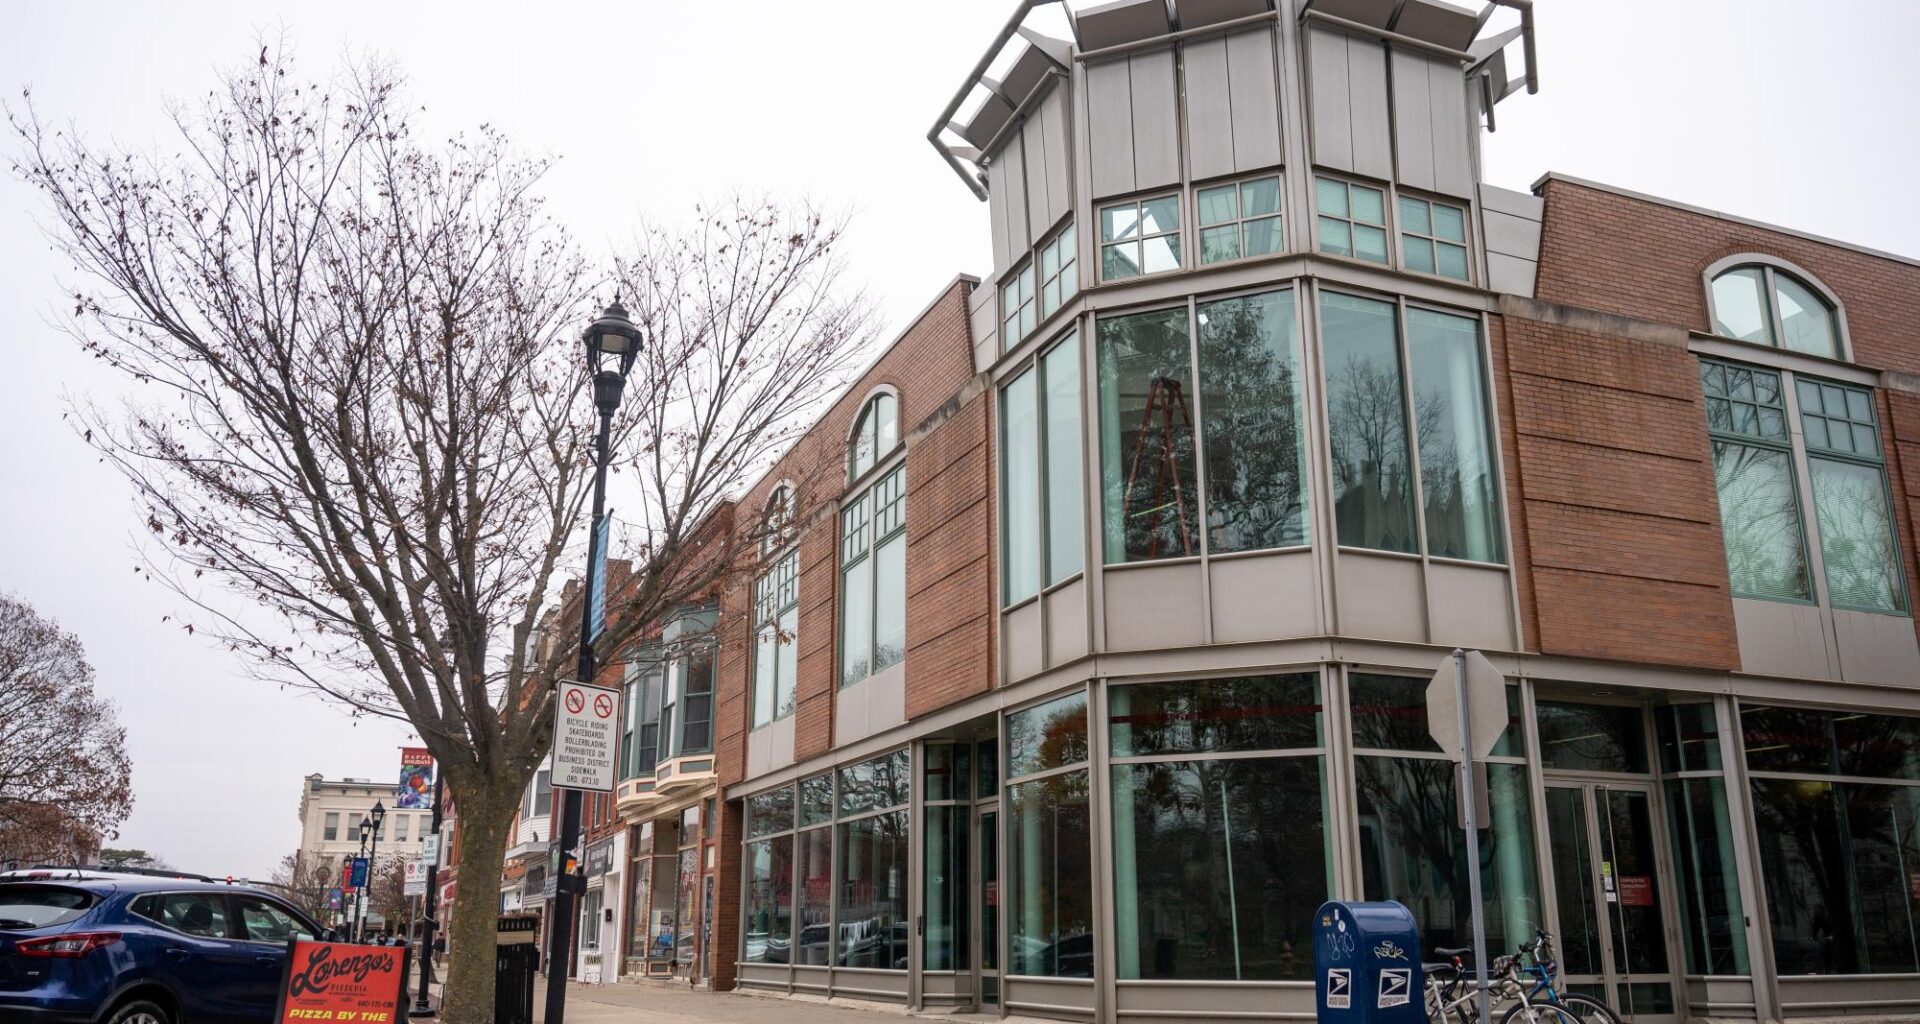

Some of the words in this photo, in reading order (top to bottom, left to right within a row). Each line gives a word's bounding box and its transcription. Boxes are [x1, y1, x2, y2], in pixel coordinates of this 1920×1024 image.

[567, 718, 588, 728] BICYCLE
[591, 721, 608, 731] RIDING
[569, 727, 605, 740] SKATEBOARDS
[565, 737, 607, 749] ROLLERBLADING
[565, 746, 596, 757] PROHIBITED
[598, 750, 606, 758] ON
[558, 755, 585, 765] BUSINESS
[587, 759, 610, 768] DISTRICT
[571, 766, 597, 776] SIDEWALK
[290, 945, 394, 998] Lorenzo's
[331, 984, 368, 992] PIZZERIA
[289, 1009, 333, 1019] PIZZA
[336, 1011, 357, 1020] BY
[361, 1012, 389, 1022] THE
